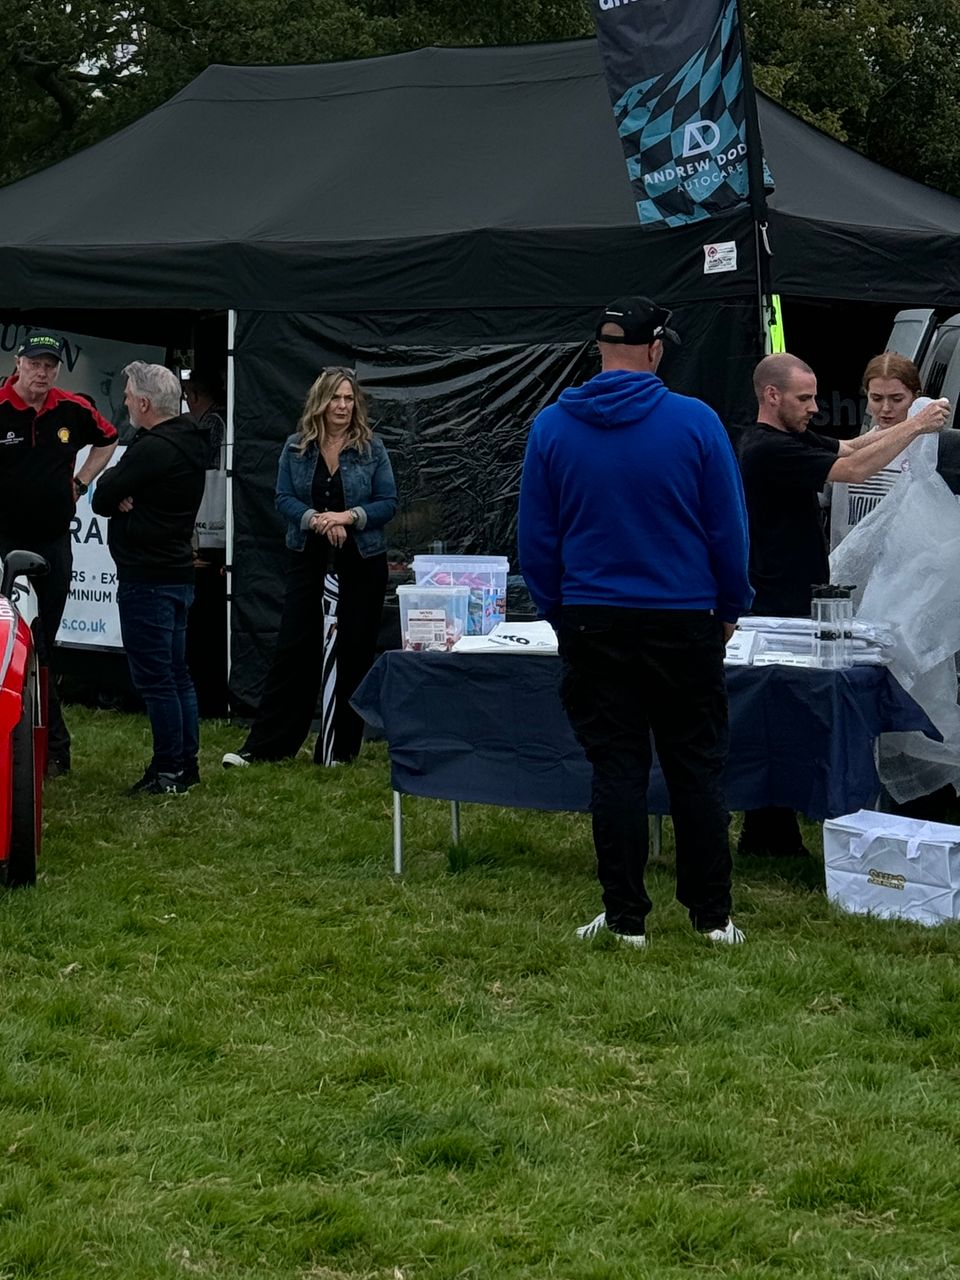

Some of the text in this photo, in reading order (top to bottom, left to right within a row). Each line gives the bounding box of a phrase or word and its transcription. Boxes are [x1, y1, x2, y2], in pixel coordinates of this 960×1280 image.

[643, 143, 748, 186] ANDREW DOD
[676, 162, 743, 193] AUTOCARE
[68, 589, 112, 603] MINIUM
